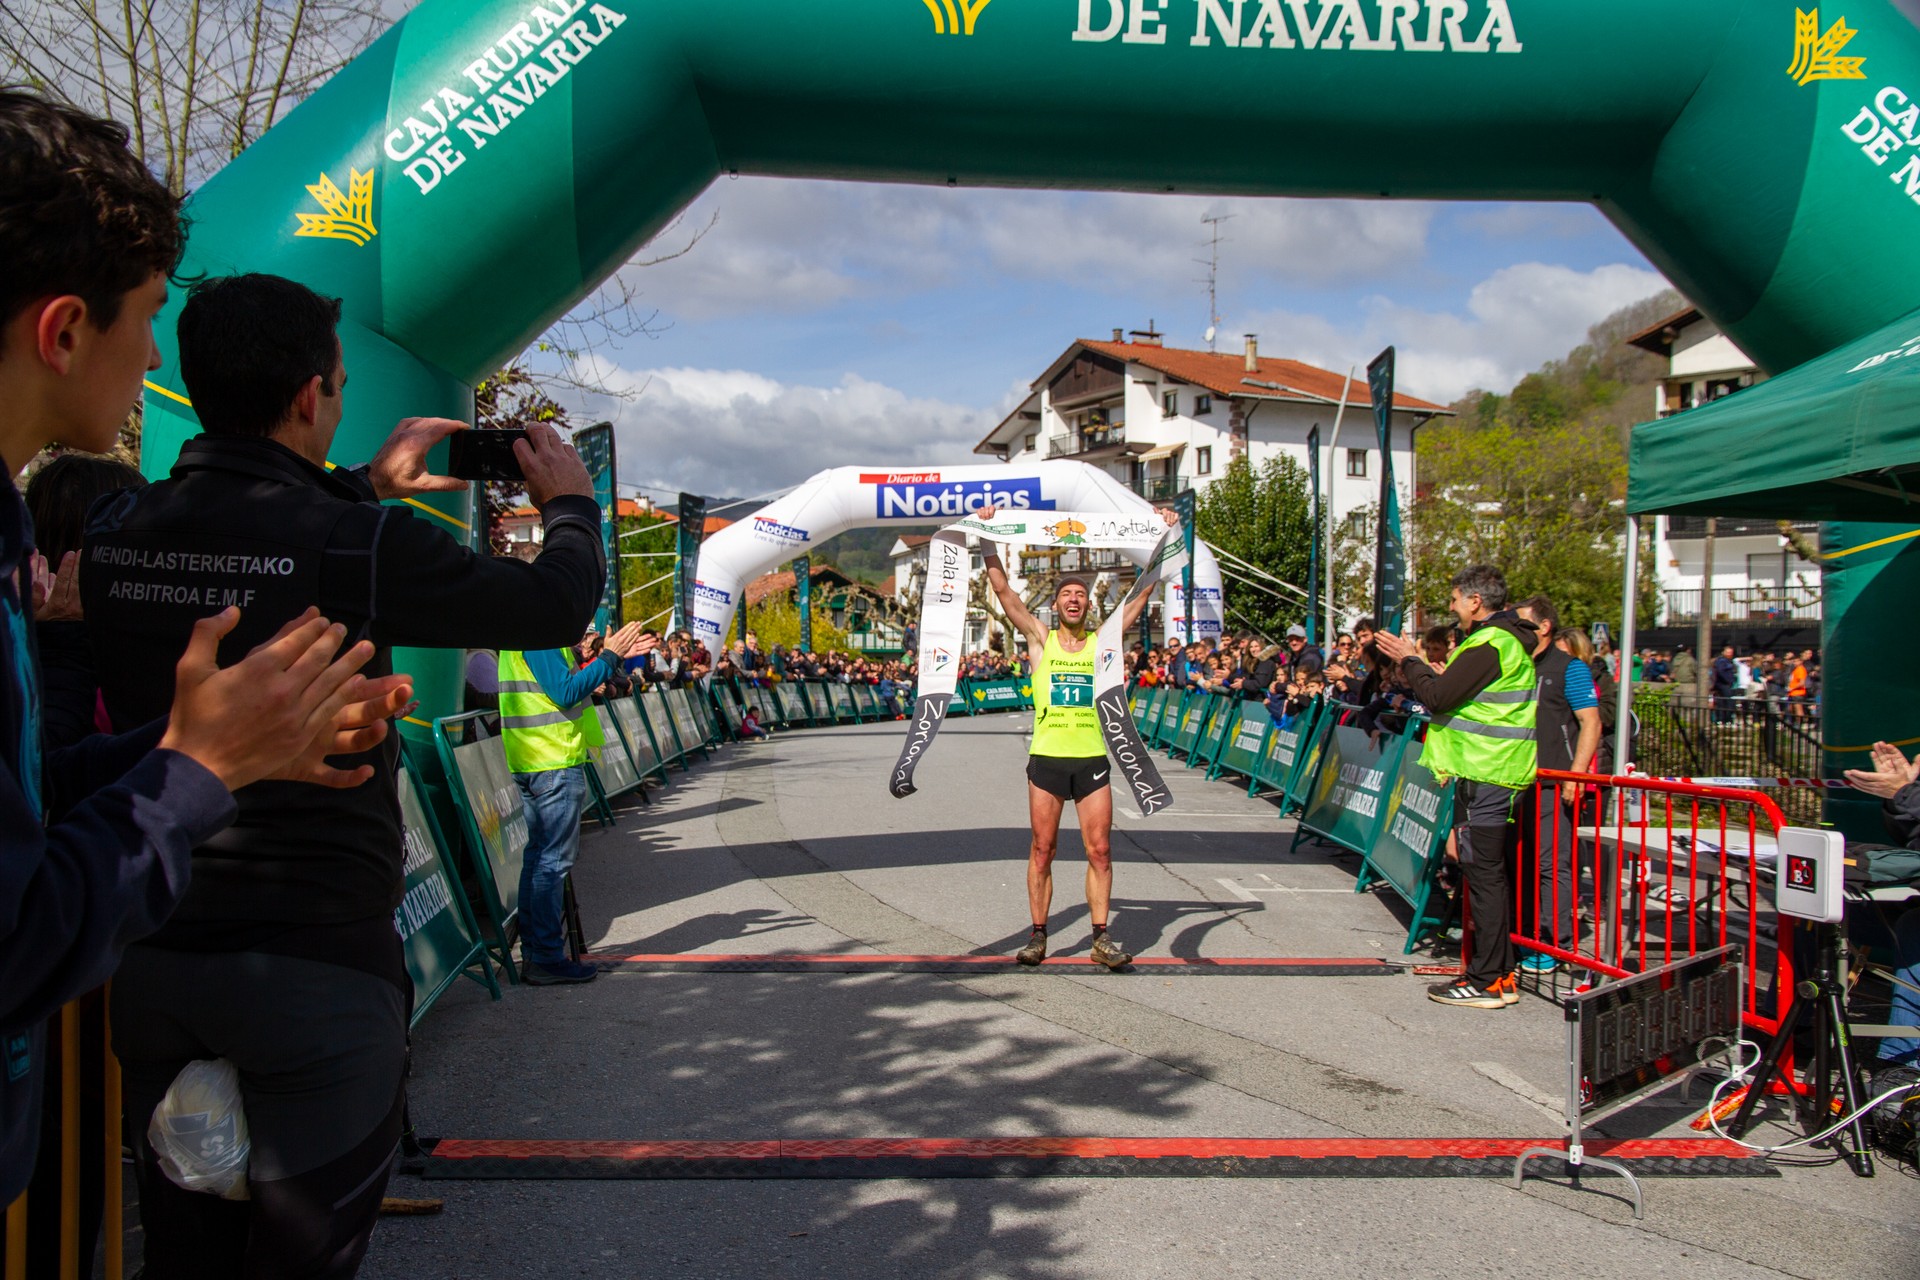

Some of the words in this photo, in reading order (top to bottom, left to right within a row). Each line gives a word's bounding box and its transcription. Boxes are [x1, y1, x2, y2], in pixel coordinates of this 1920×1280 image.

[1072, 0, 1167, 45] DE
[1190, 0, 1523, 53] NAVARRA
[384, 87, 475, 162] CAJA
[463, 0, 587, 95] RURAL
[402, 135, 467, 196] DE
[457, 3, 627, 150] NAVARRA
[1840, 105, 1904, 166] DE
[1874, 86, 1920, 150] CA
[883, 483, 1031, 517] Noticias
[887, 474, 922, 483] Diario
[924, 473, 938, 483] de
[755, 520, 804, 540] Noticias
[91, 545, 295, 575] MENDI-LASTERKETAKO
[940, 544, 959, 603] Zalain
[109, 580, 200, 605] ARBITROA
[1062, 687, 1080, 702] 11
[896, 699, 944, 796] Zorionak
[1100, 695, 1166, 815] Zorionak
[403, 827, 434, 877] URAL
[402, 870, 452, 935] NAVARRA
